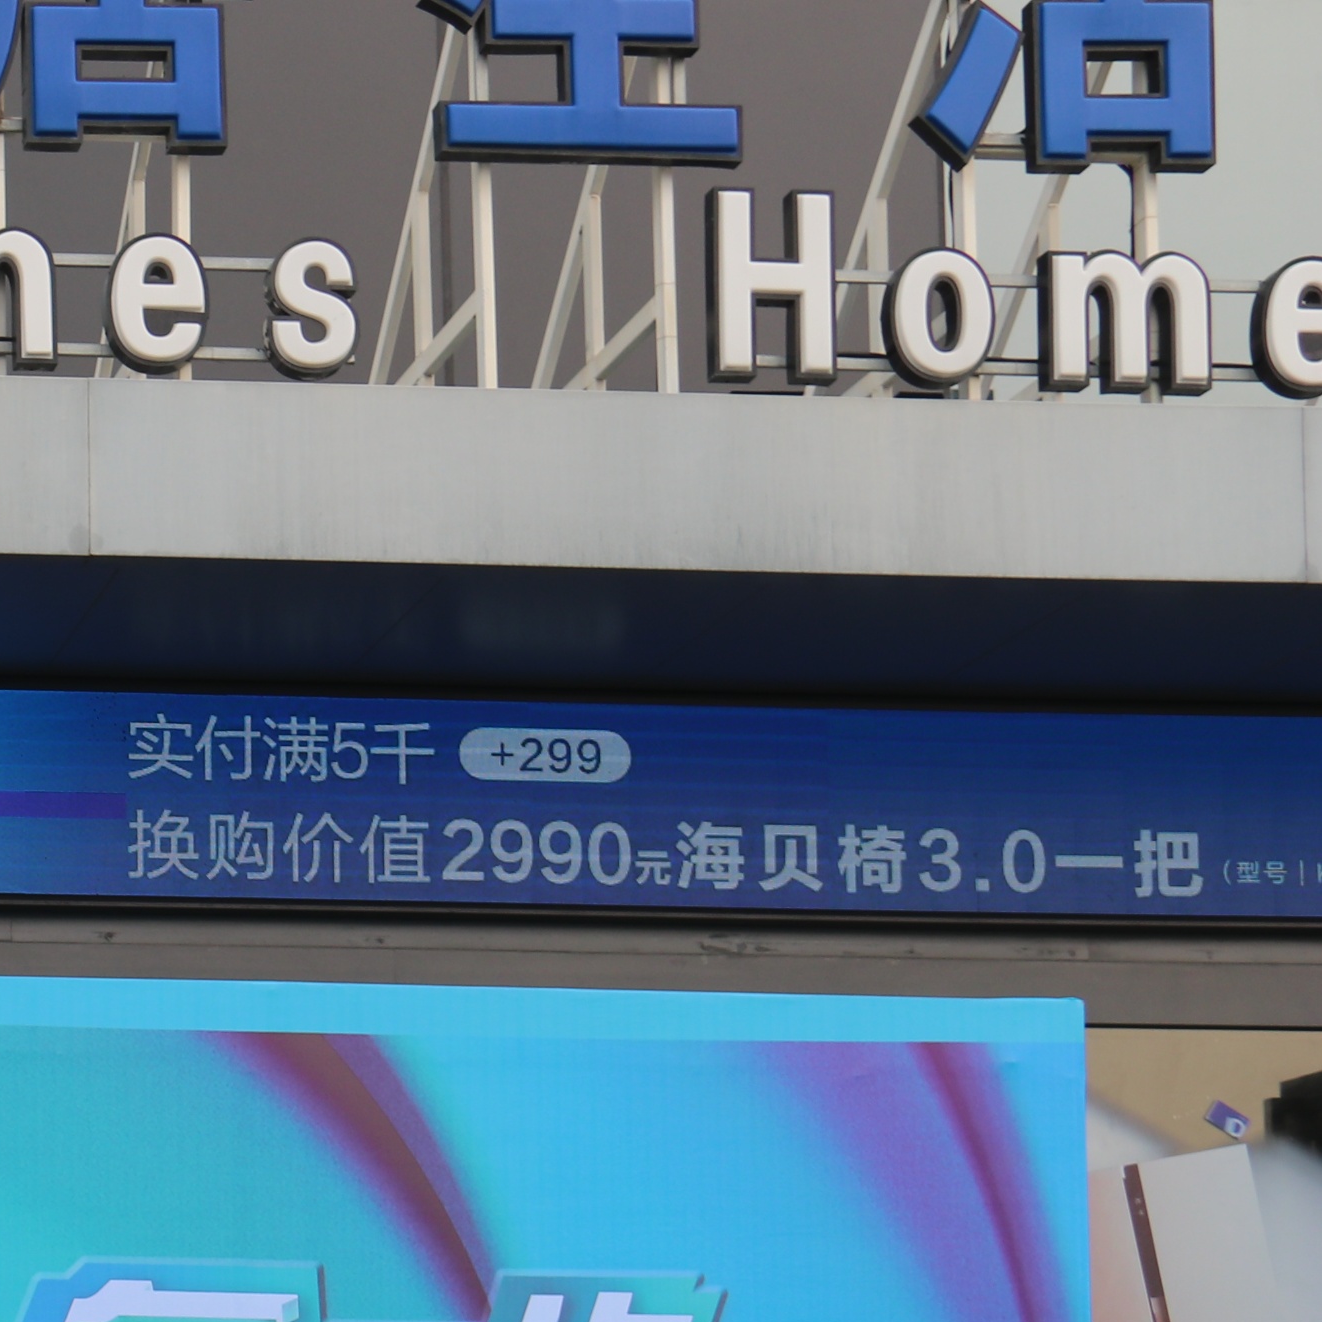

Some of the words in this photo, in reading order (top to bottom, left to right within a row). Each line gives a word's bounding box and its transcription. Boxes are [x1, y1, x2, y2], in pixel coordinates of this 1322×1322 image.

[128, 713, 435, 785] 实付满5千
[490, 737, 603, 774] +299
